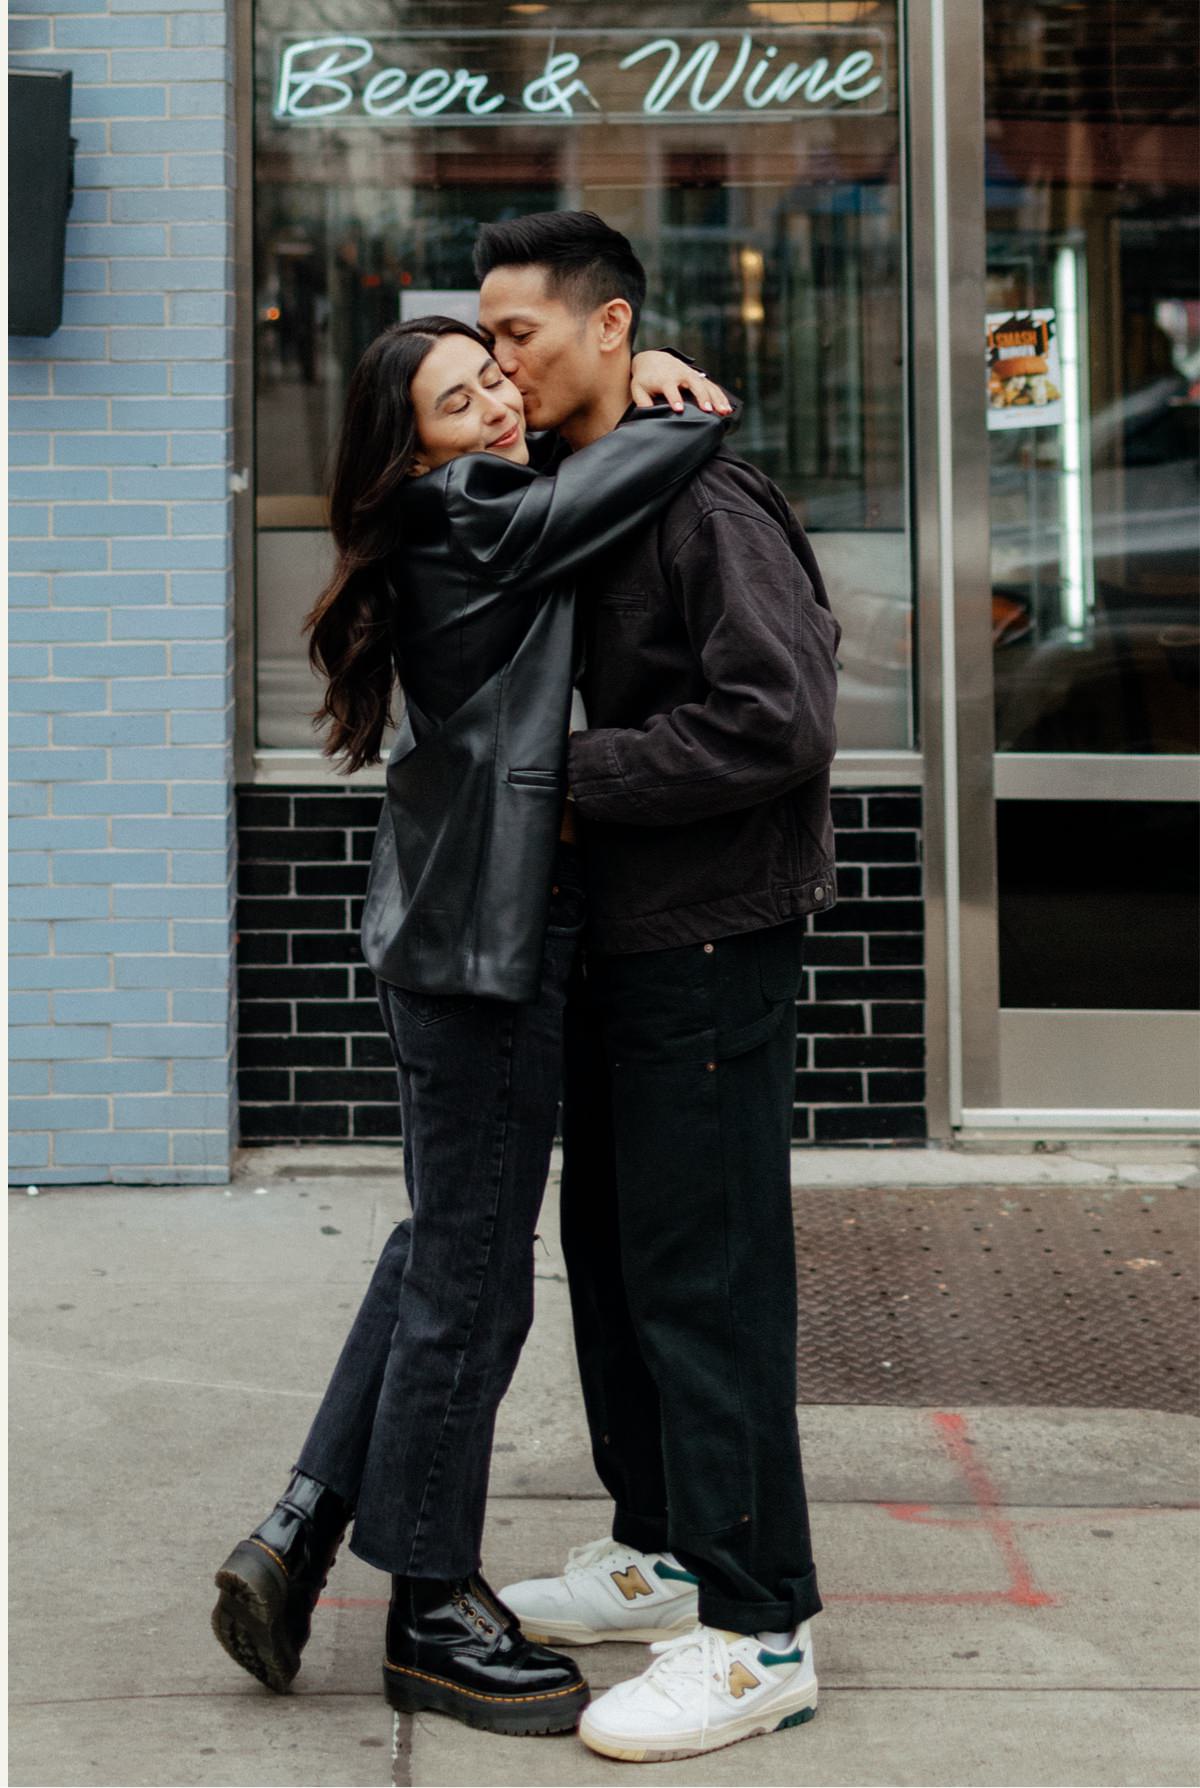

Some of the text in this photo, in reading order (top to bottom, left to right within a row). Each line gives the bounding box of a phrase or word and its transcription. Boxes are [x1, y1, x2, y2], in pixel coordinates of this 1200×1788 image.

[275, 33, 883, 118] Beer & Wine
